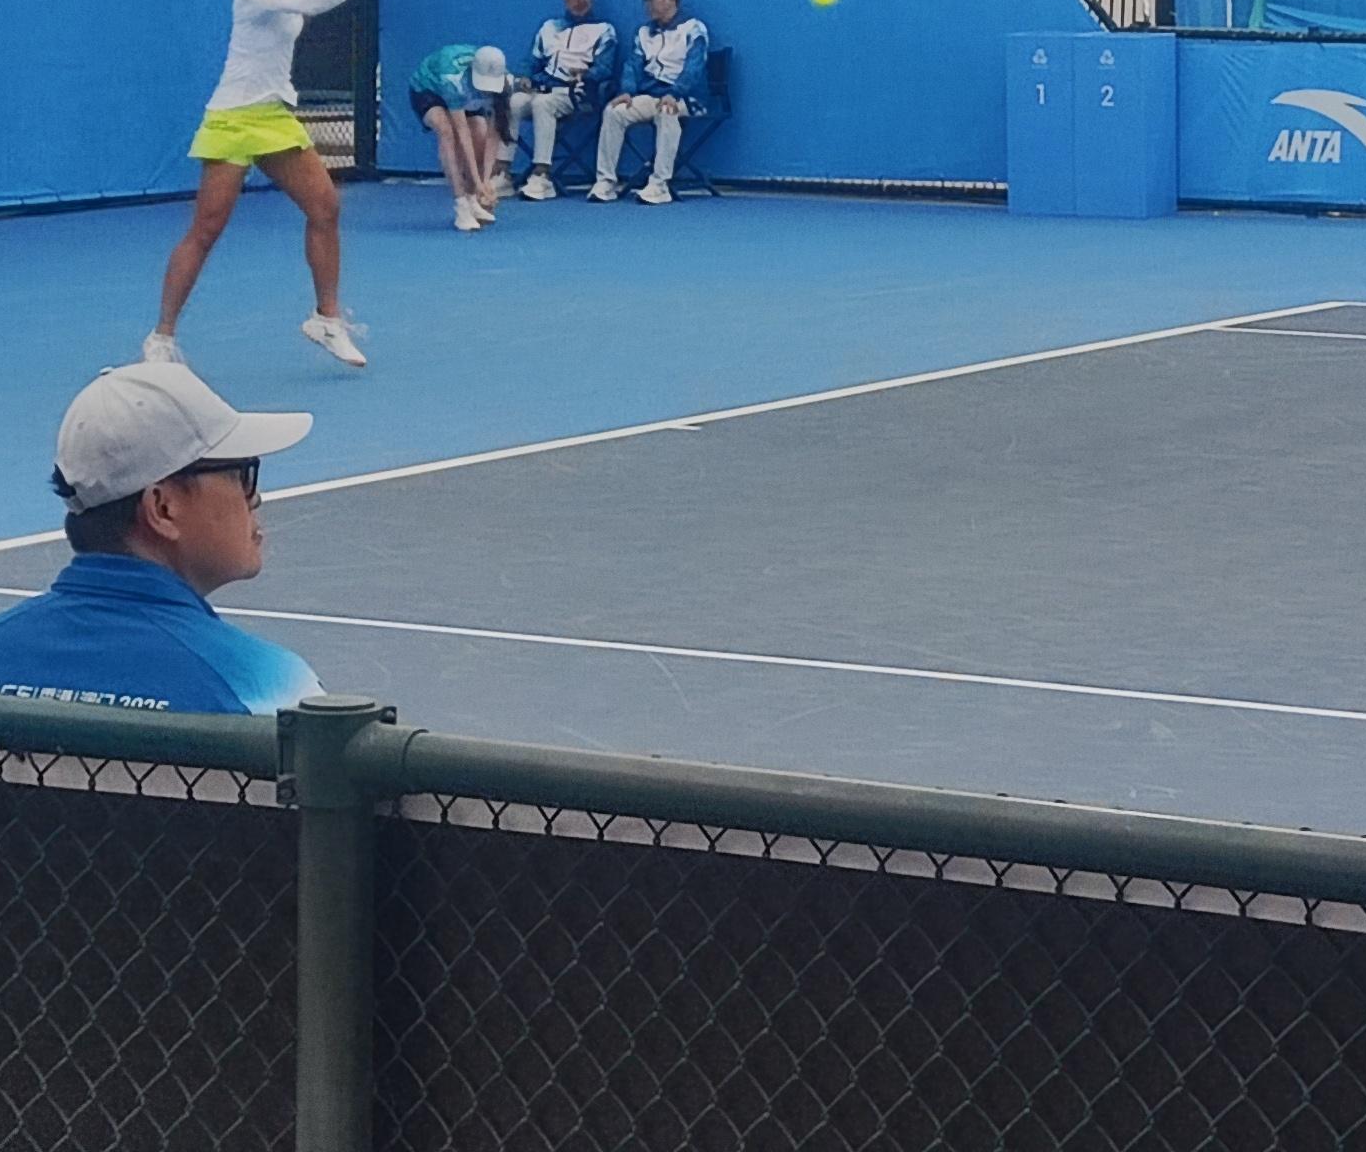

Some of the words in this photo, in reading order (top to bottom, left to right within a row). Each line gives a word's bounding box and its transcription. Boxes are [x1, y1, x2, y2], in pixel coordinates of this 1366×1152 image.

[1035, 83, 1046, 105] 1
[1101, 84, 1115, 107] 2
[1268, 130, 1342, 164] ANTA
